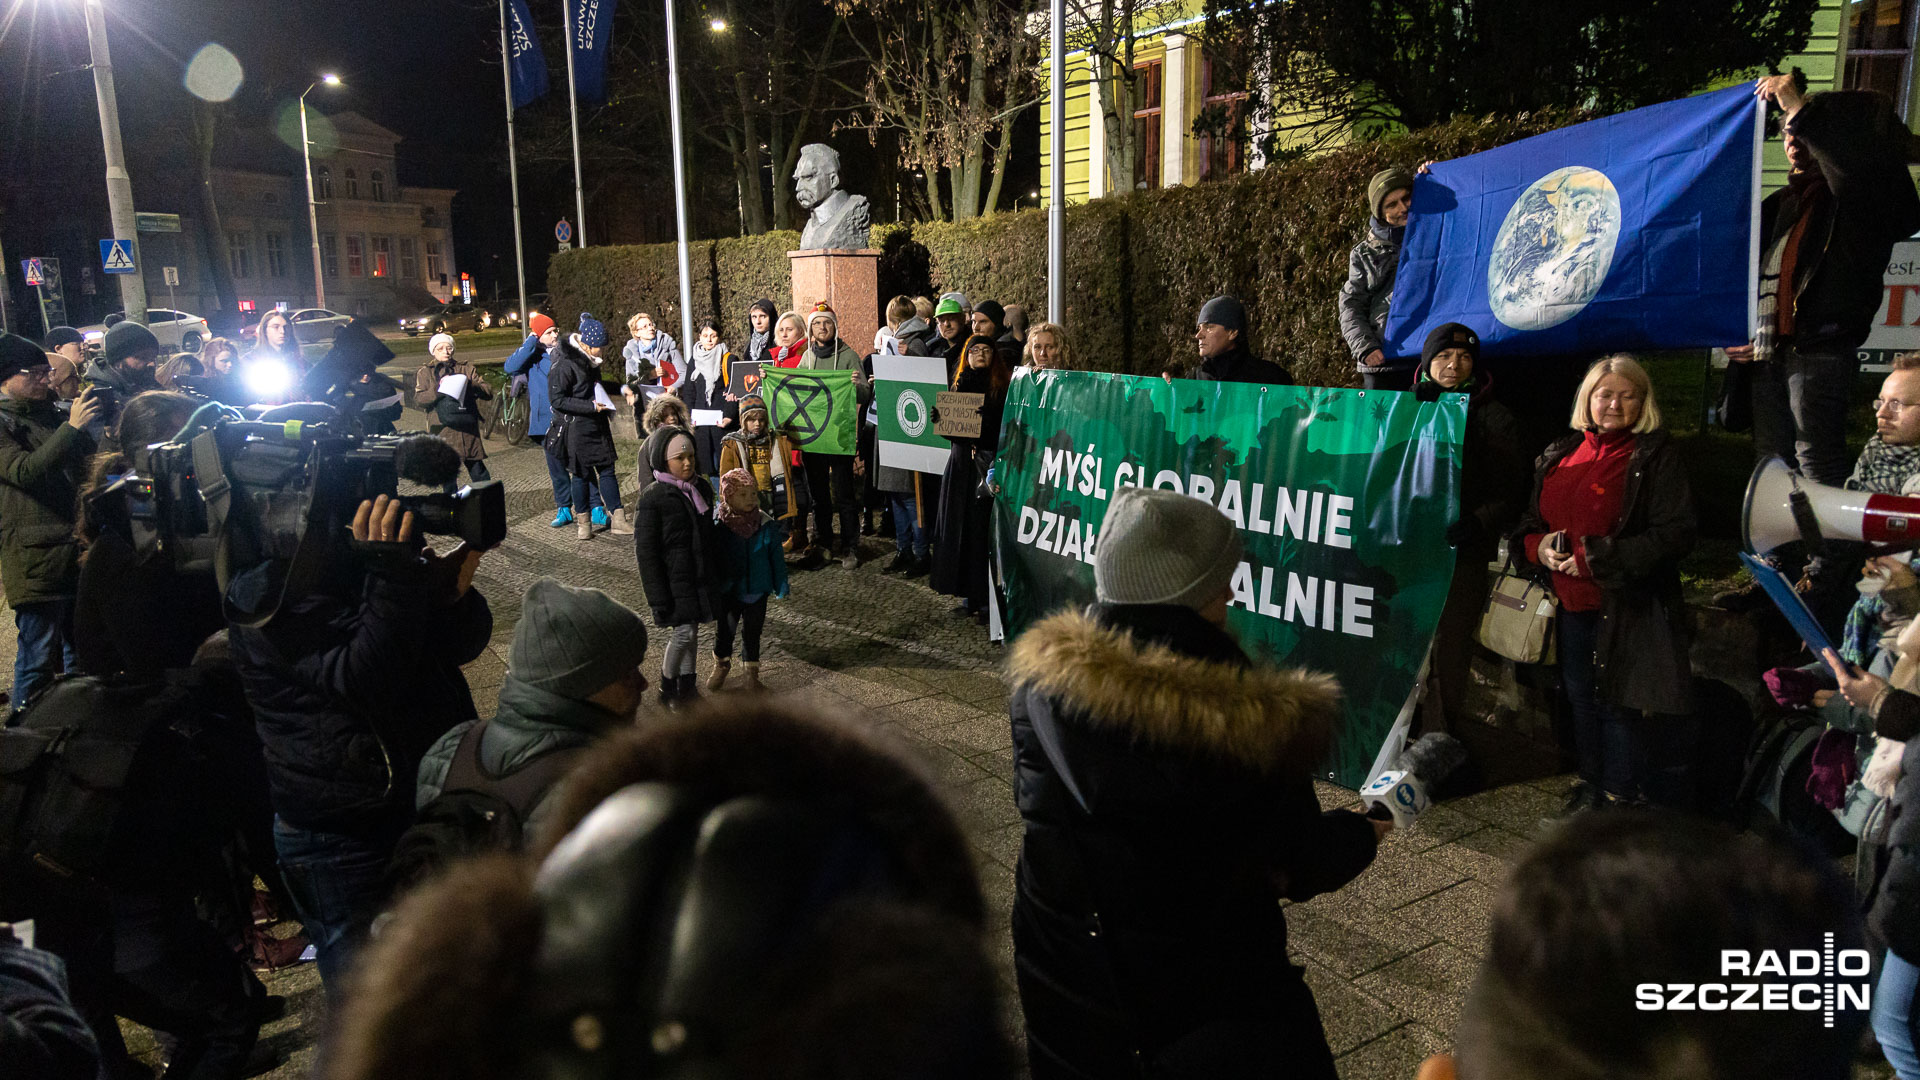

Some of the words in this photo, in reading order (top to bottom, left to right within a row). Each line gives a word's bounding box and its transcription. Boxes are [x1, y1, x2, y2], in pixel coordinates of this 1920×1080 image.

[585, 0, 599, 50] SZCZE
[1887, 260, 1920, 275] est-
[1880, 284, 1920, 327] T
[939, 407, 950, 417] TO
[953, 407, 978, 420] MIASTA
[1038, 443, 1106, 500] MYŚL
[1017, 505, 1096, 567] DZIAŁ
[1226, 561, 1374, 638] ALNIE
